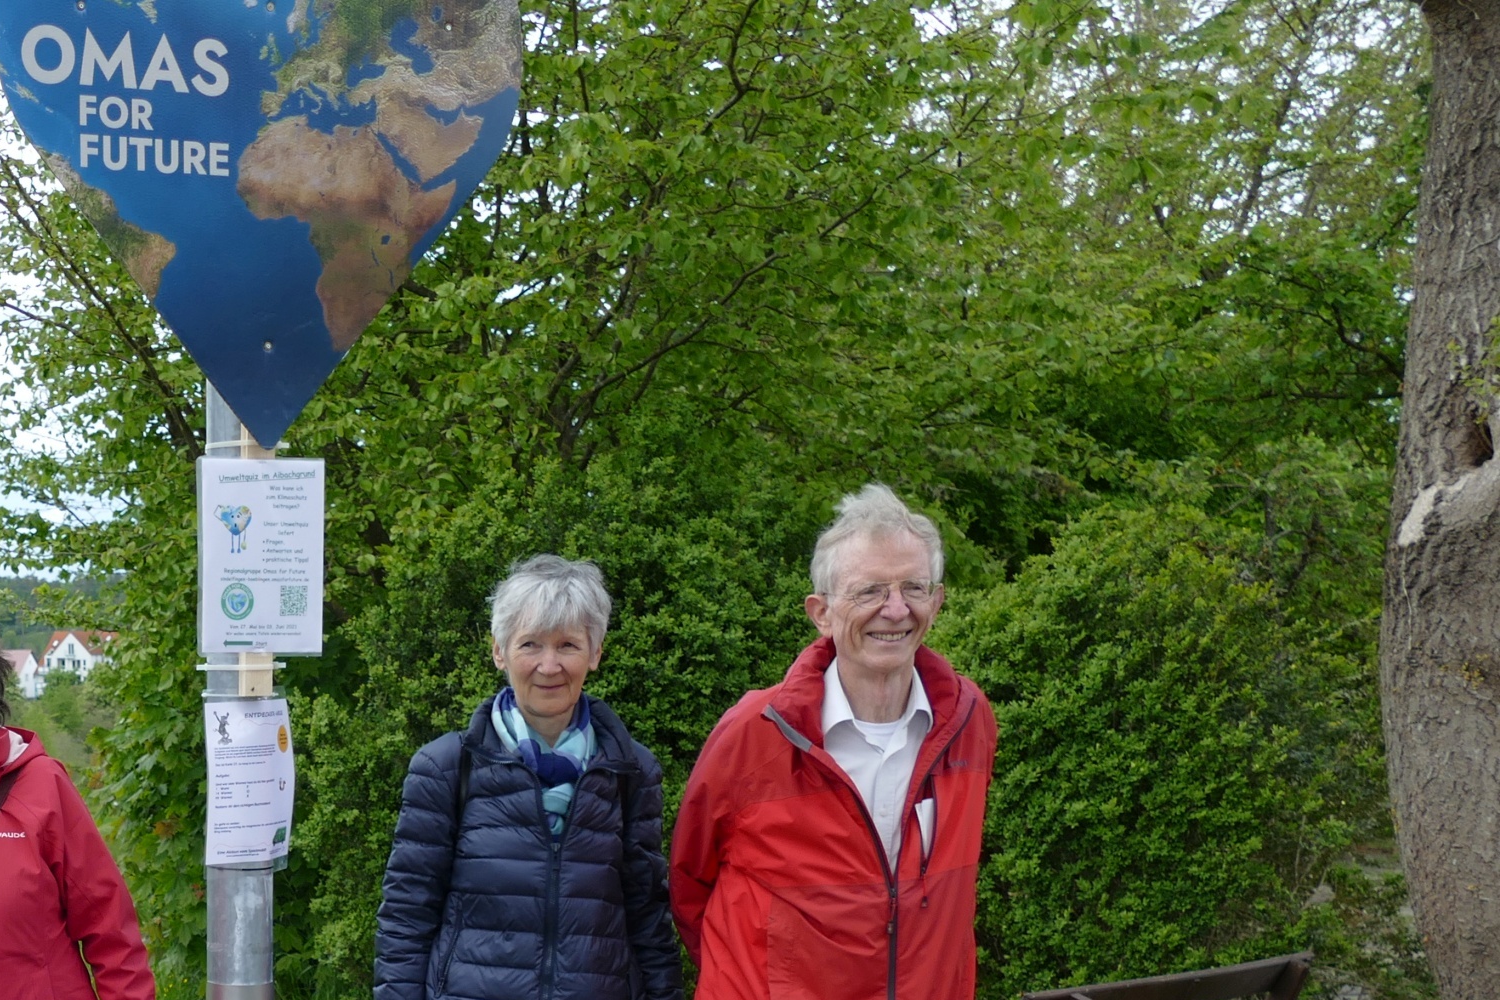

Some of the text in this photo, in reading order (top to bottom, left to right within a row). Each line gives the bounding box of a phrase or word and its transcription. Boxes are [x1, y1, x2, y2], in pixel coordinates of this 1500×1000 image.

[21, 24, 230, 97] OMAS
[79, 95, 154, 131] FOR
[79, 134, 230, 177] FUTURE
[218, 469, 316, 482] Umweltquiz im Aibachgrund
[223, 567, 261, 575] Regionalgruppe
